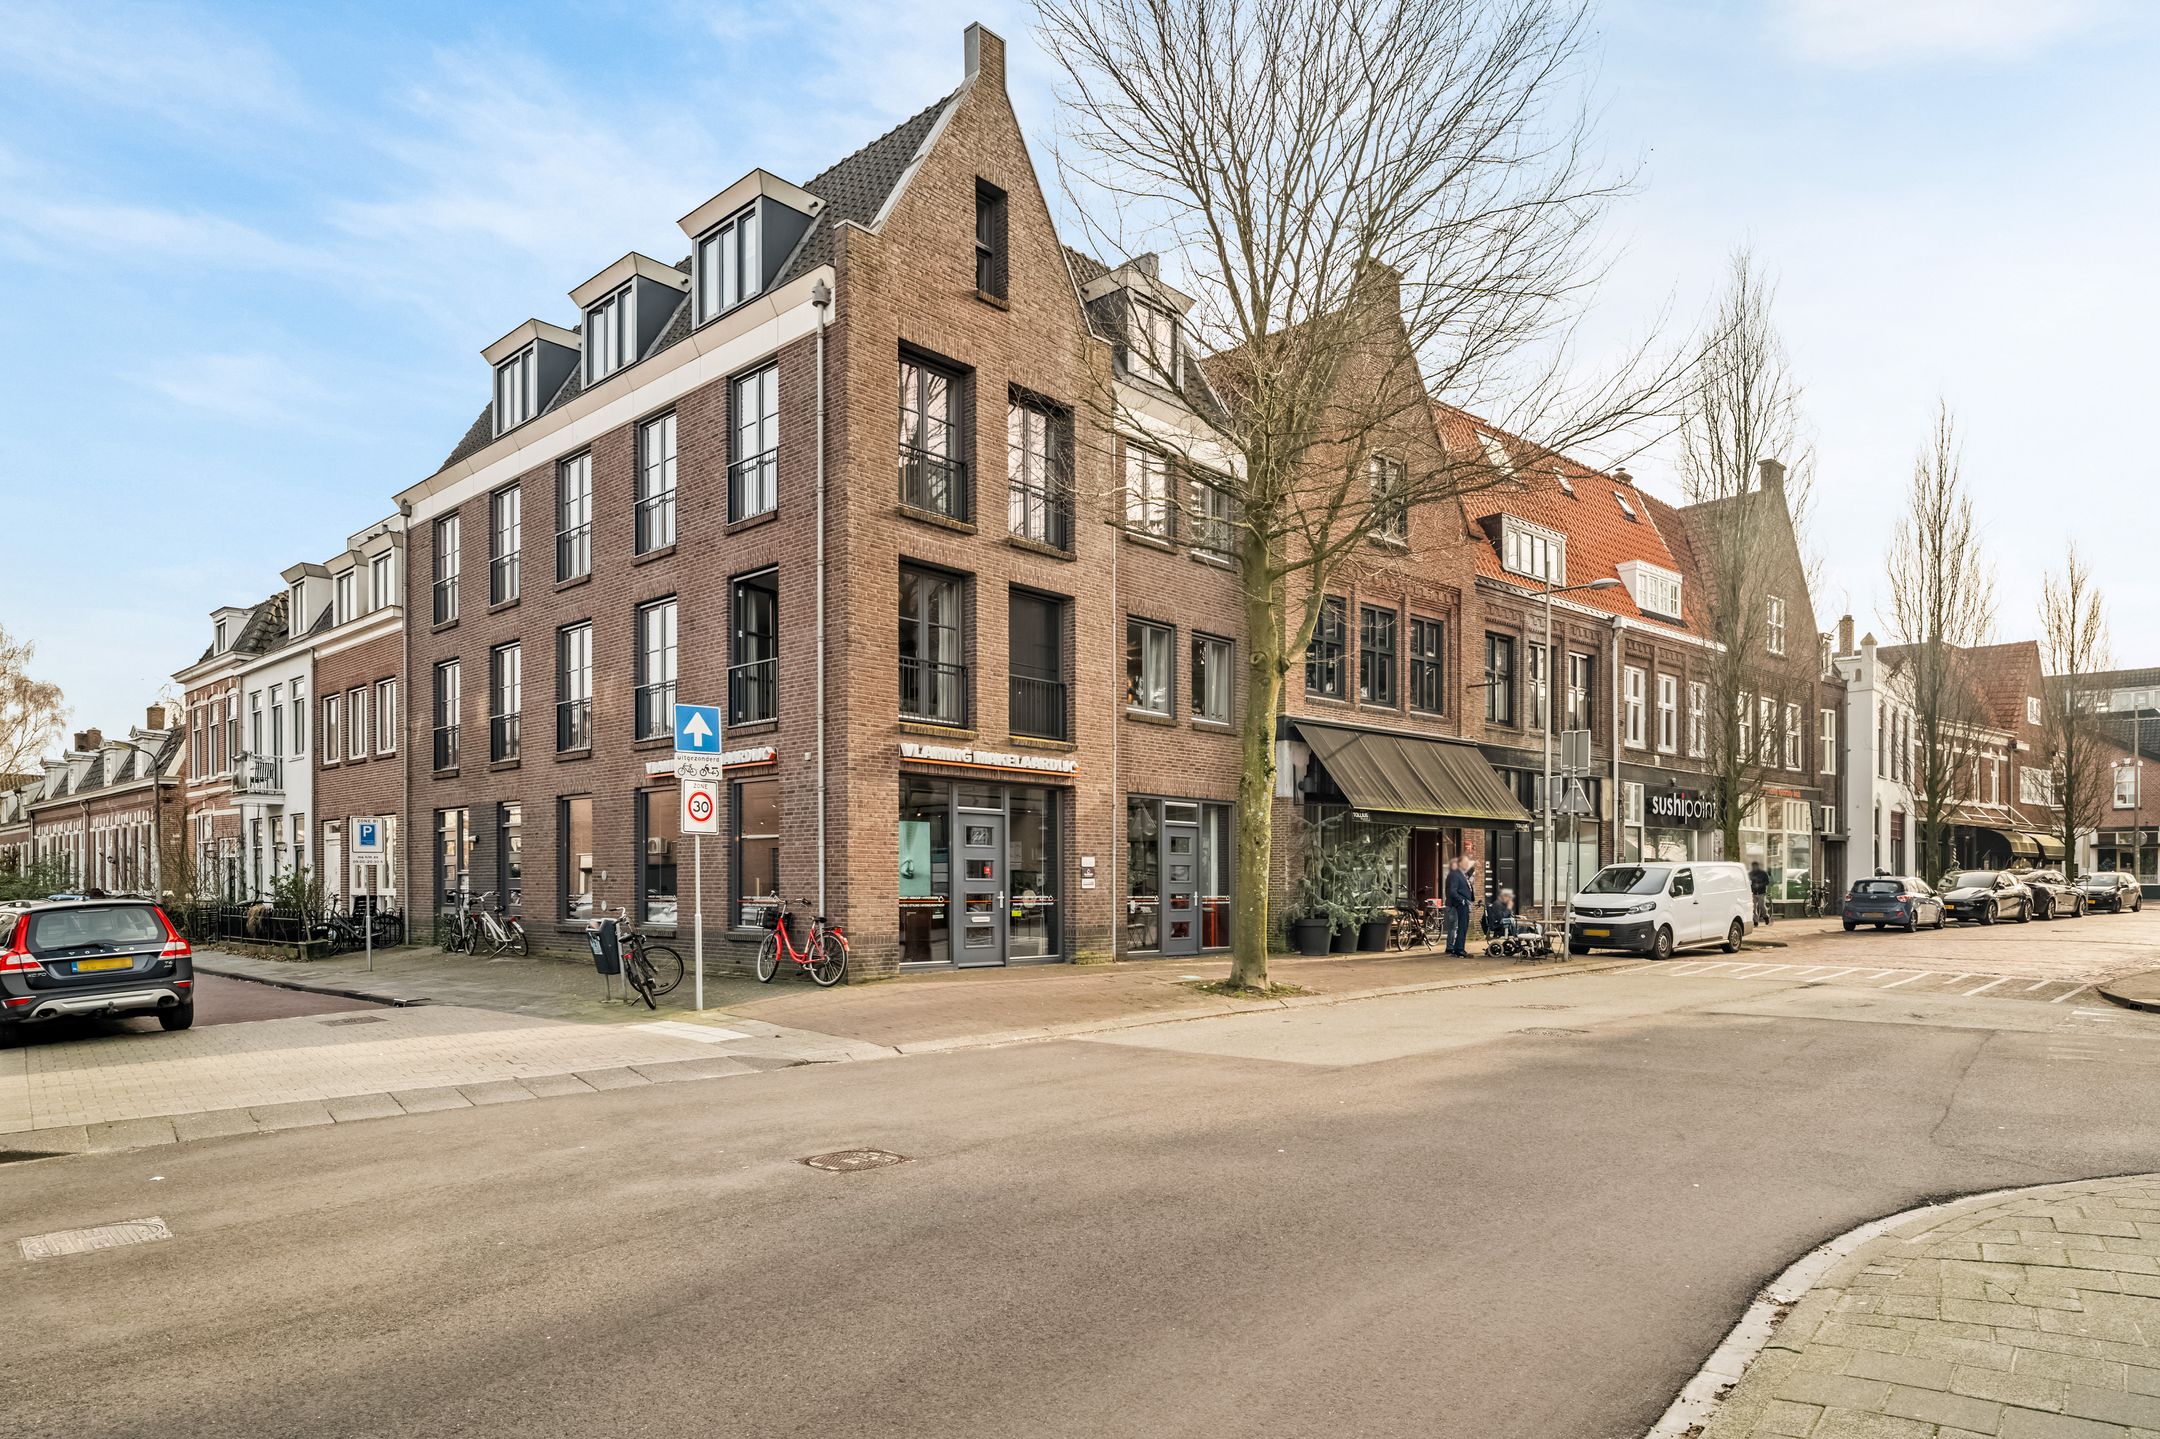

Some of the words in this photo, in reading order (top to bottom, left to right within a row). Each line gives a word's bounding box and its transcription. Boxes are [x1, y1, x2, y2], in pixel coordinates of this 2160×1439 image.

[900, 743, 973, 763] VLAMING
[677, 755, 720, 763] uitgezonderd
[692, 801, 710, 812] 30
[363, 826, 372, 837] P
[68, 946, 135, 956] VOLVO
